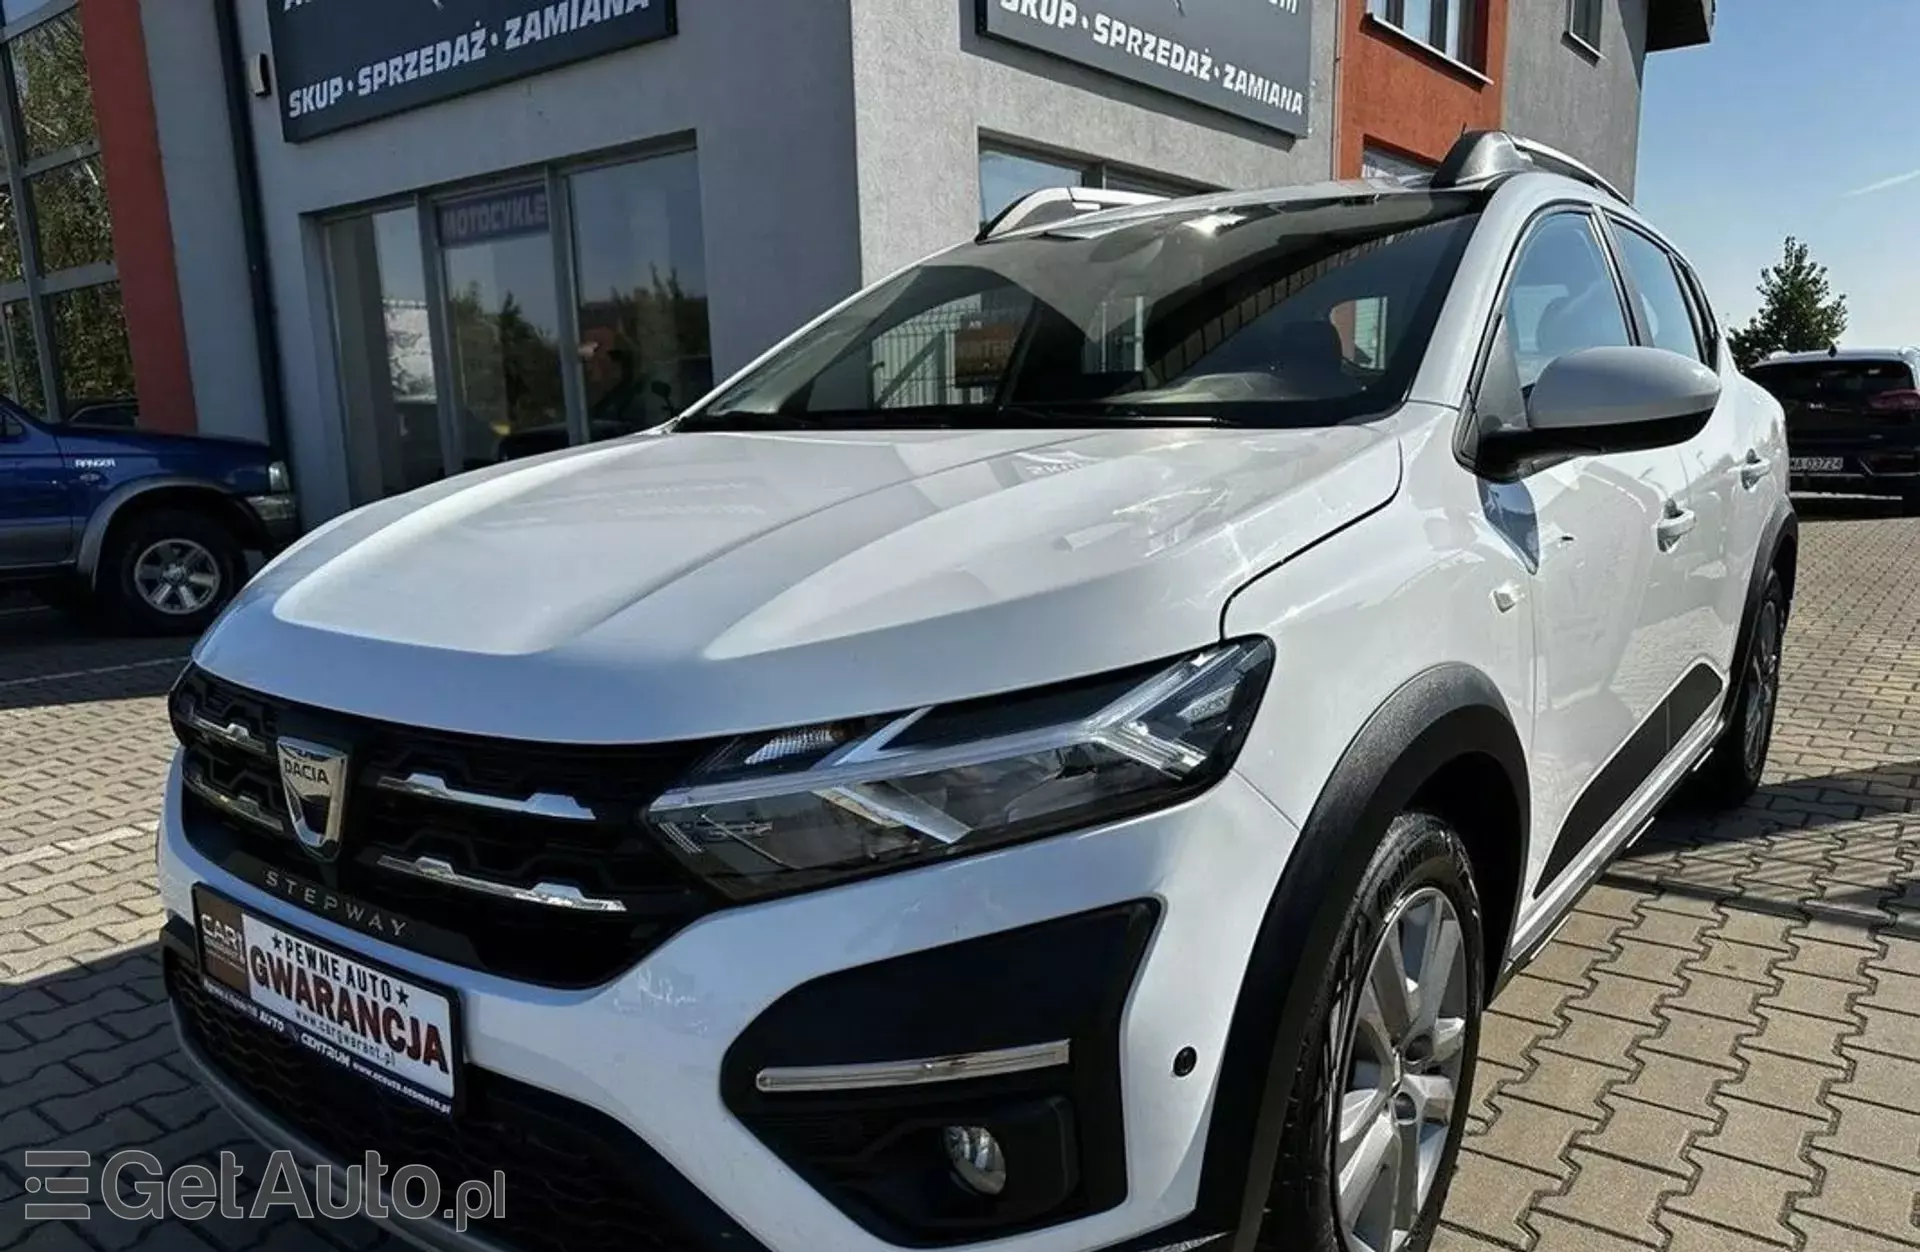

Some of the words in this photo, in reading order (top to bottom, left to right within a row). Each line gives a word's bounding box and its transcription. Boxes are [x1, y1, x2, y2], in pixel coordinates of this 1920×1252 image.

[289, 79, 343, 118] SKUP
[357, 21, 486, 97] SPRZEDAŻ
[1093, 12, 1211, 81] SPRZEDAŻ
[1222, 63, 1304, 116] ZAMIANA
[441, 191, 546, 237] MOTOCYKLE
[75, 458, 116, 468] RANGER
[284, 759, 329, 785] DACIA
[264, 870, 408, 937] STEPWAY
[284, 938, 341, 984] PEWNE
[346, 966, 392, 1006] AUTO
[249, 945, 449, 1075] GWARANCJA
[259, 1011, 284, 1032] AUTO
